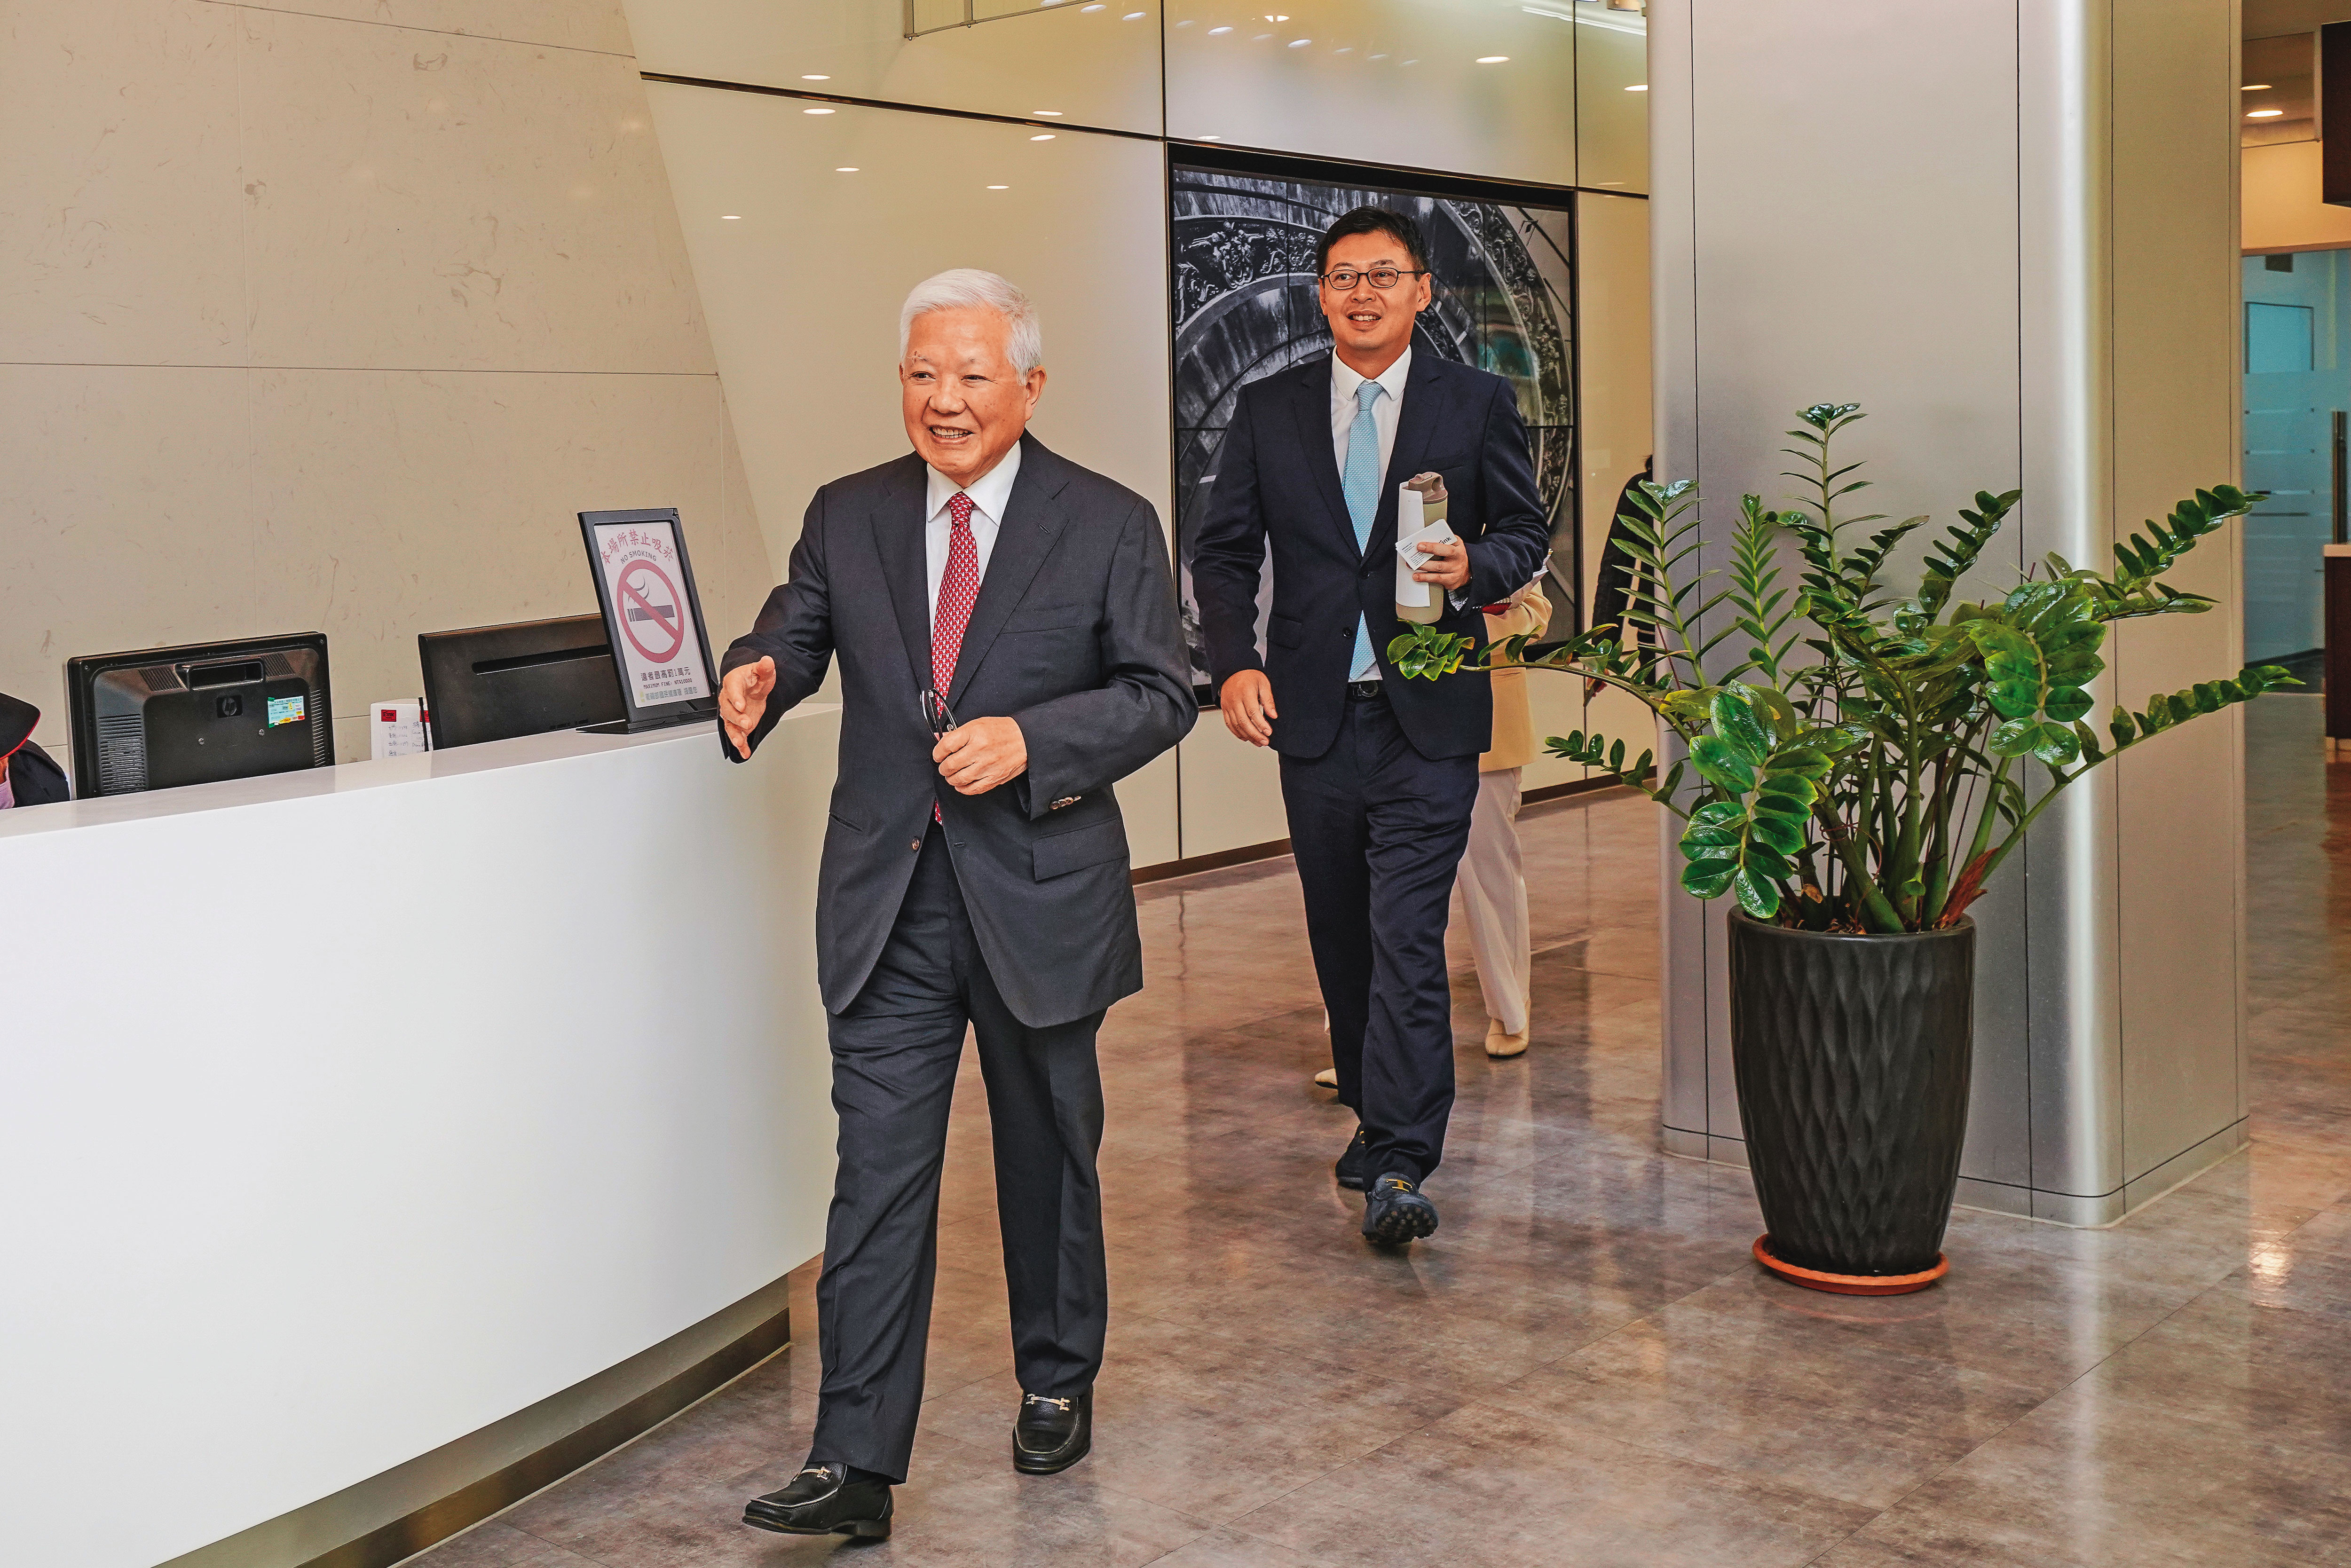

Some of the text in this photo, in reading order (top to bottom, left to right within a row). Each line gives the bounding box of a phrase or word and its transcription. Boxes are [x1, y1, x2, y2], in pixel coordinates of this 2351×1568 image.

[600, 529, 674, 565] 本場所禁止吸菸
[621, 550, 656, 564] NO SMOKING
